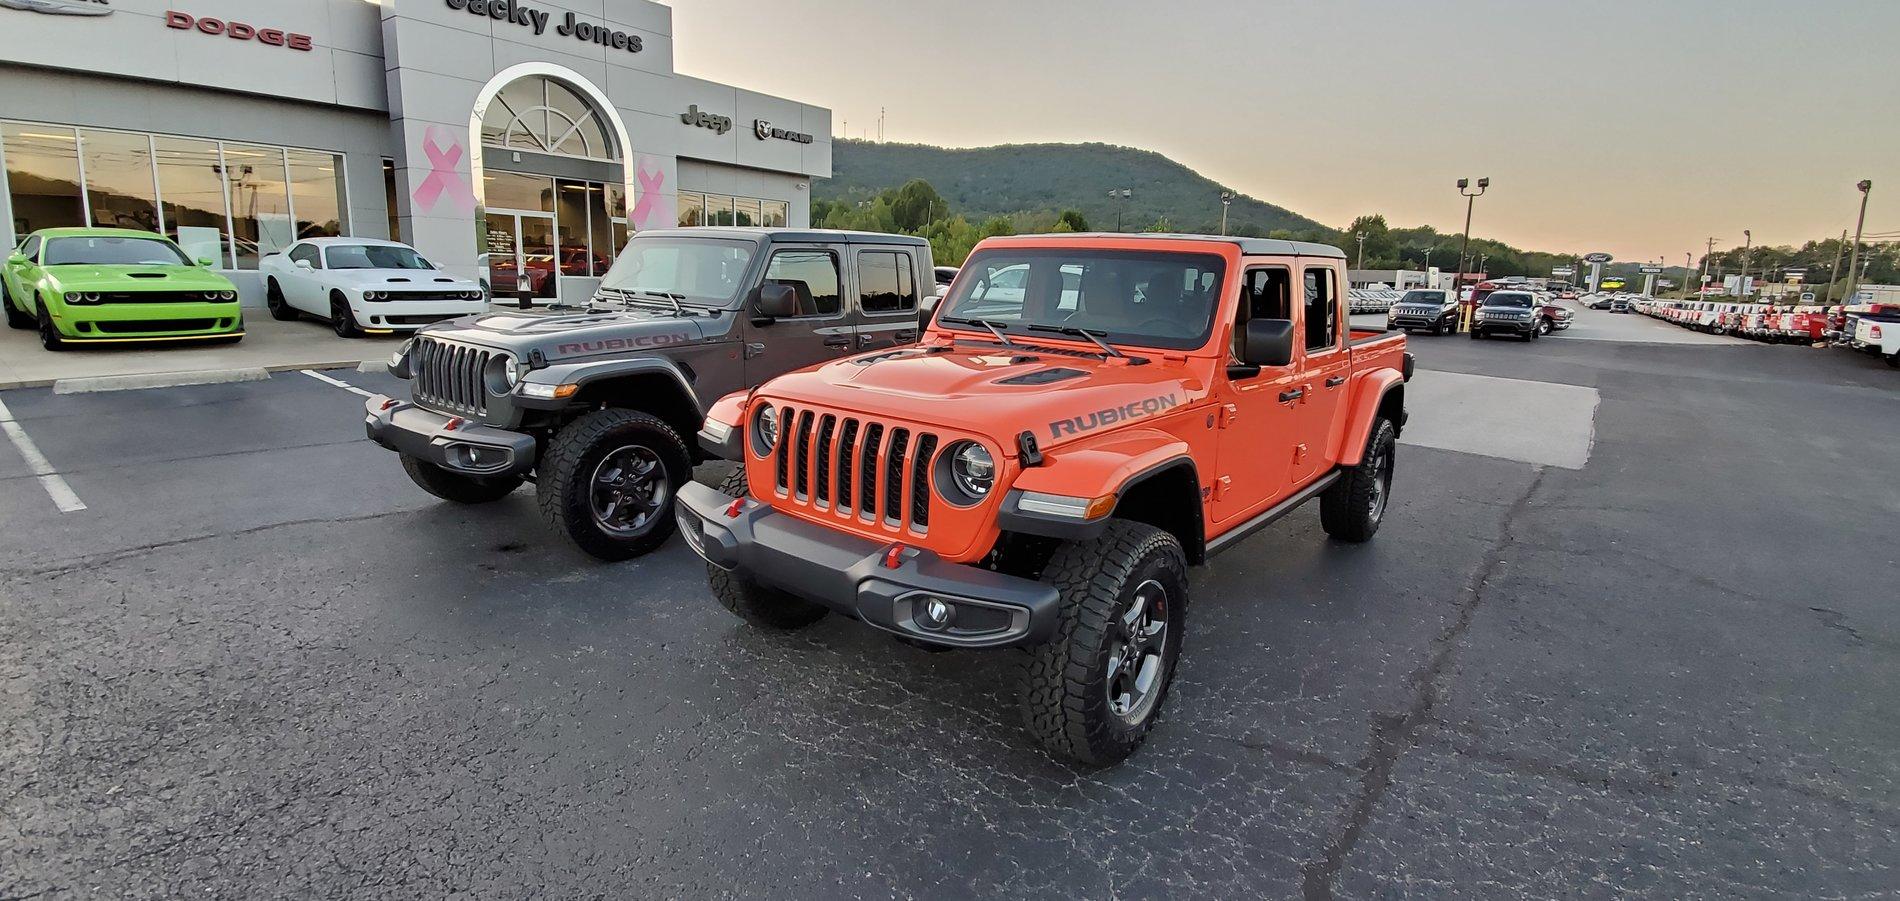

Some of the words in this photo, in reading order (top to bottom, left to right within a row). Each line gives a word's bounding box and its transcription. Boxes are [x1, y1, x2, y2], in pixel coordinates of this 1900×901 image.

[166, 10, 313, 51] DODGE
[557, 12, 643, 52] Jones
[681, 104, 732, 135] Jeep
[771, 128, 814, 144] RAM
[558, 332, 690, 355] RUBICON
[1049, 393, 1177, 439] RUBICON
